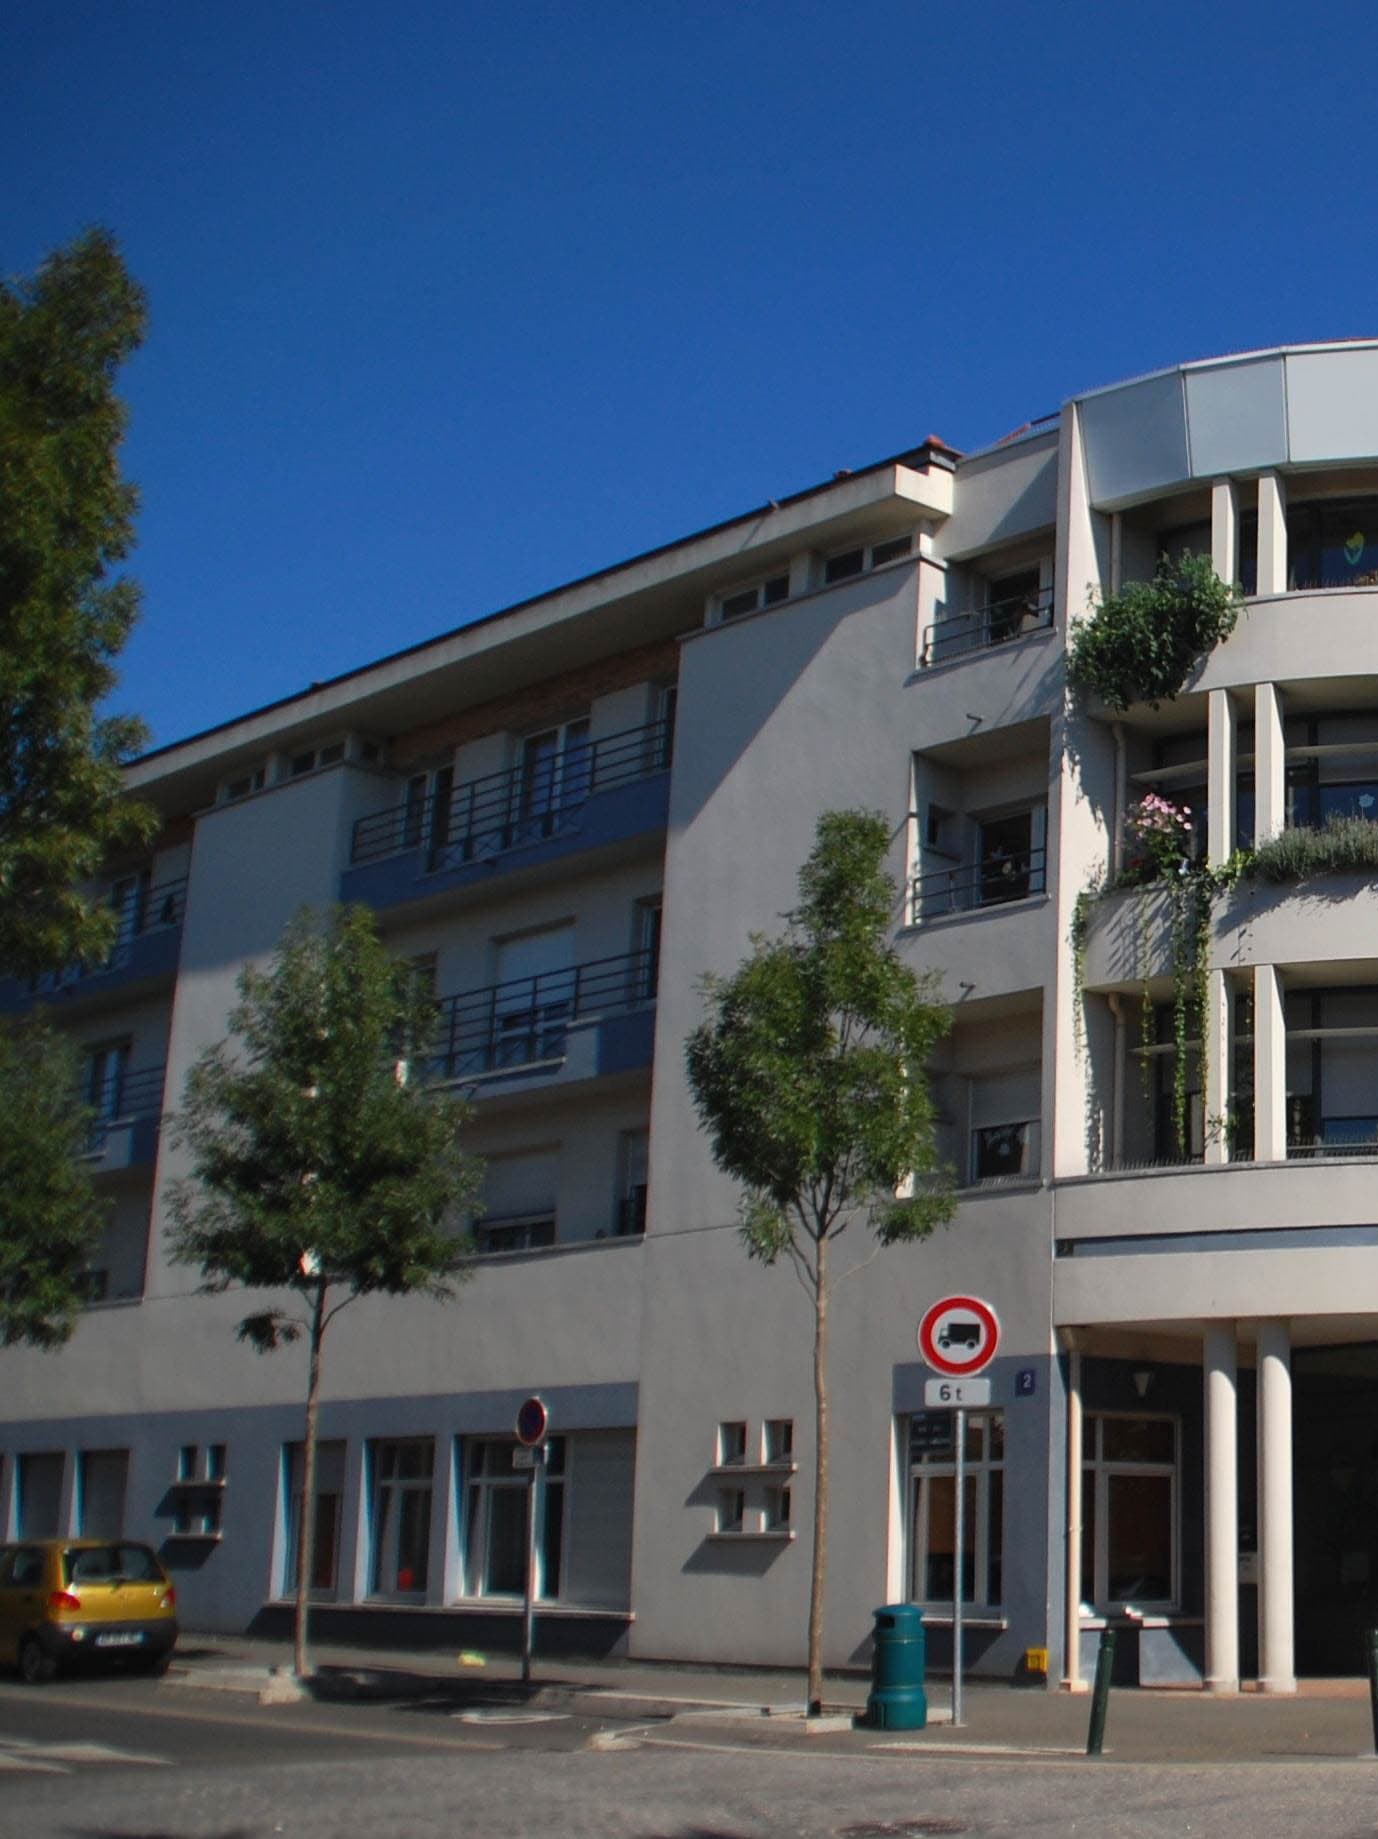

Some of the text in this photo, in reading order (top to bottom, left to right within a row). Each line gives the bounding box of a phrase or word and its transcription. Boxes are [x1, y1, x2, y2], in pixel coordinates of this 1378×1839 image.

[1023, 1374, 1032, 1388] 2
[940, 1384, 962, 1401] 6 t
